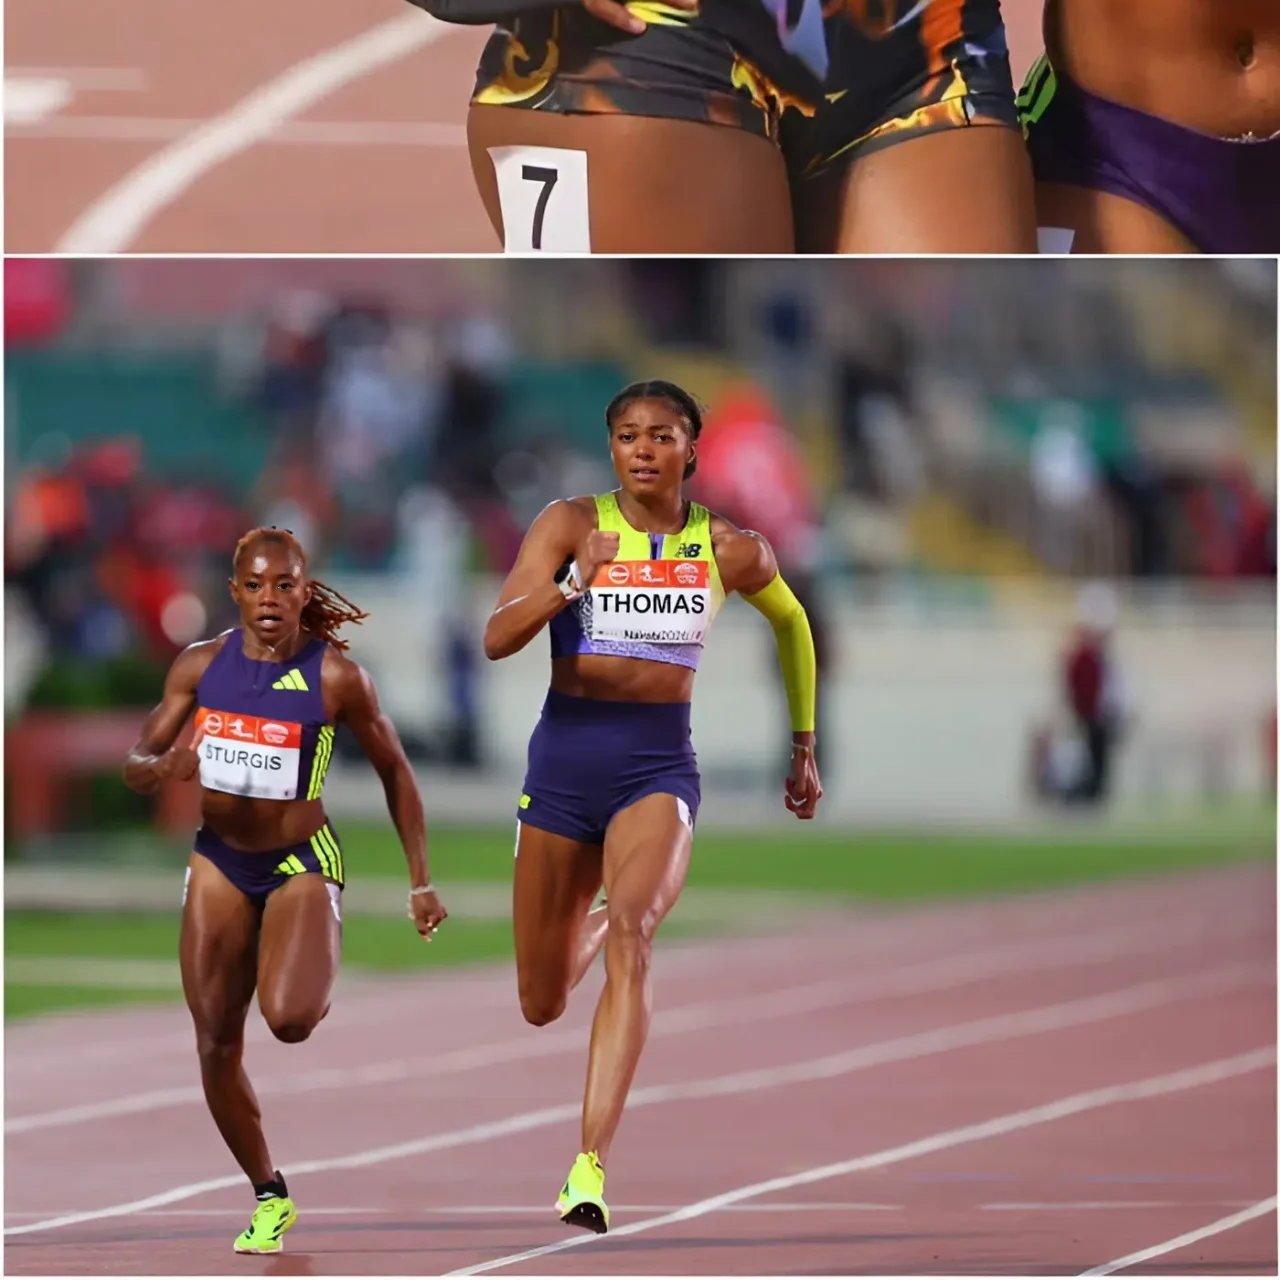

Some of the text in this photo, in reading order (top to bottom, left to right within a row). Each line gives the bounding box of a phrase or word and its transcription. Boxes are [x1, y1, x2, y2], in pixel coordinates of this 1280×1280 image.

[521, 164, 558, 250] 7
[598, 593, 705, 614] THOMAS
[205, 743, 282, 771] STURGIS
